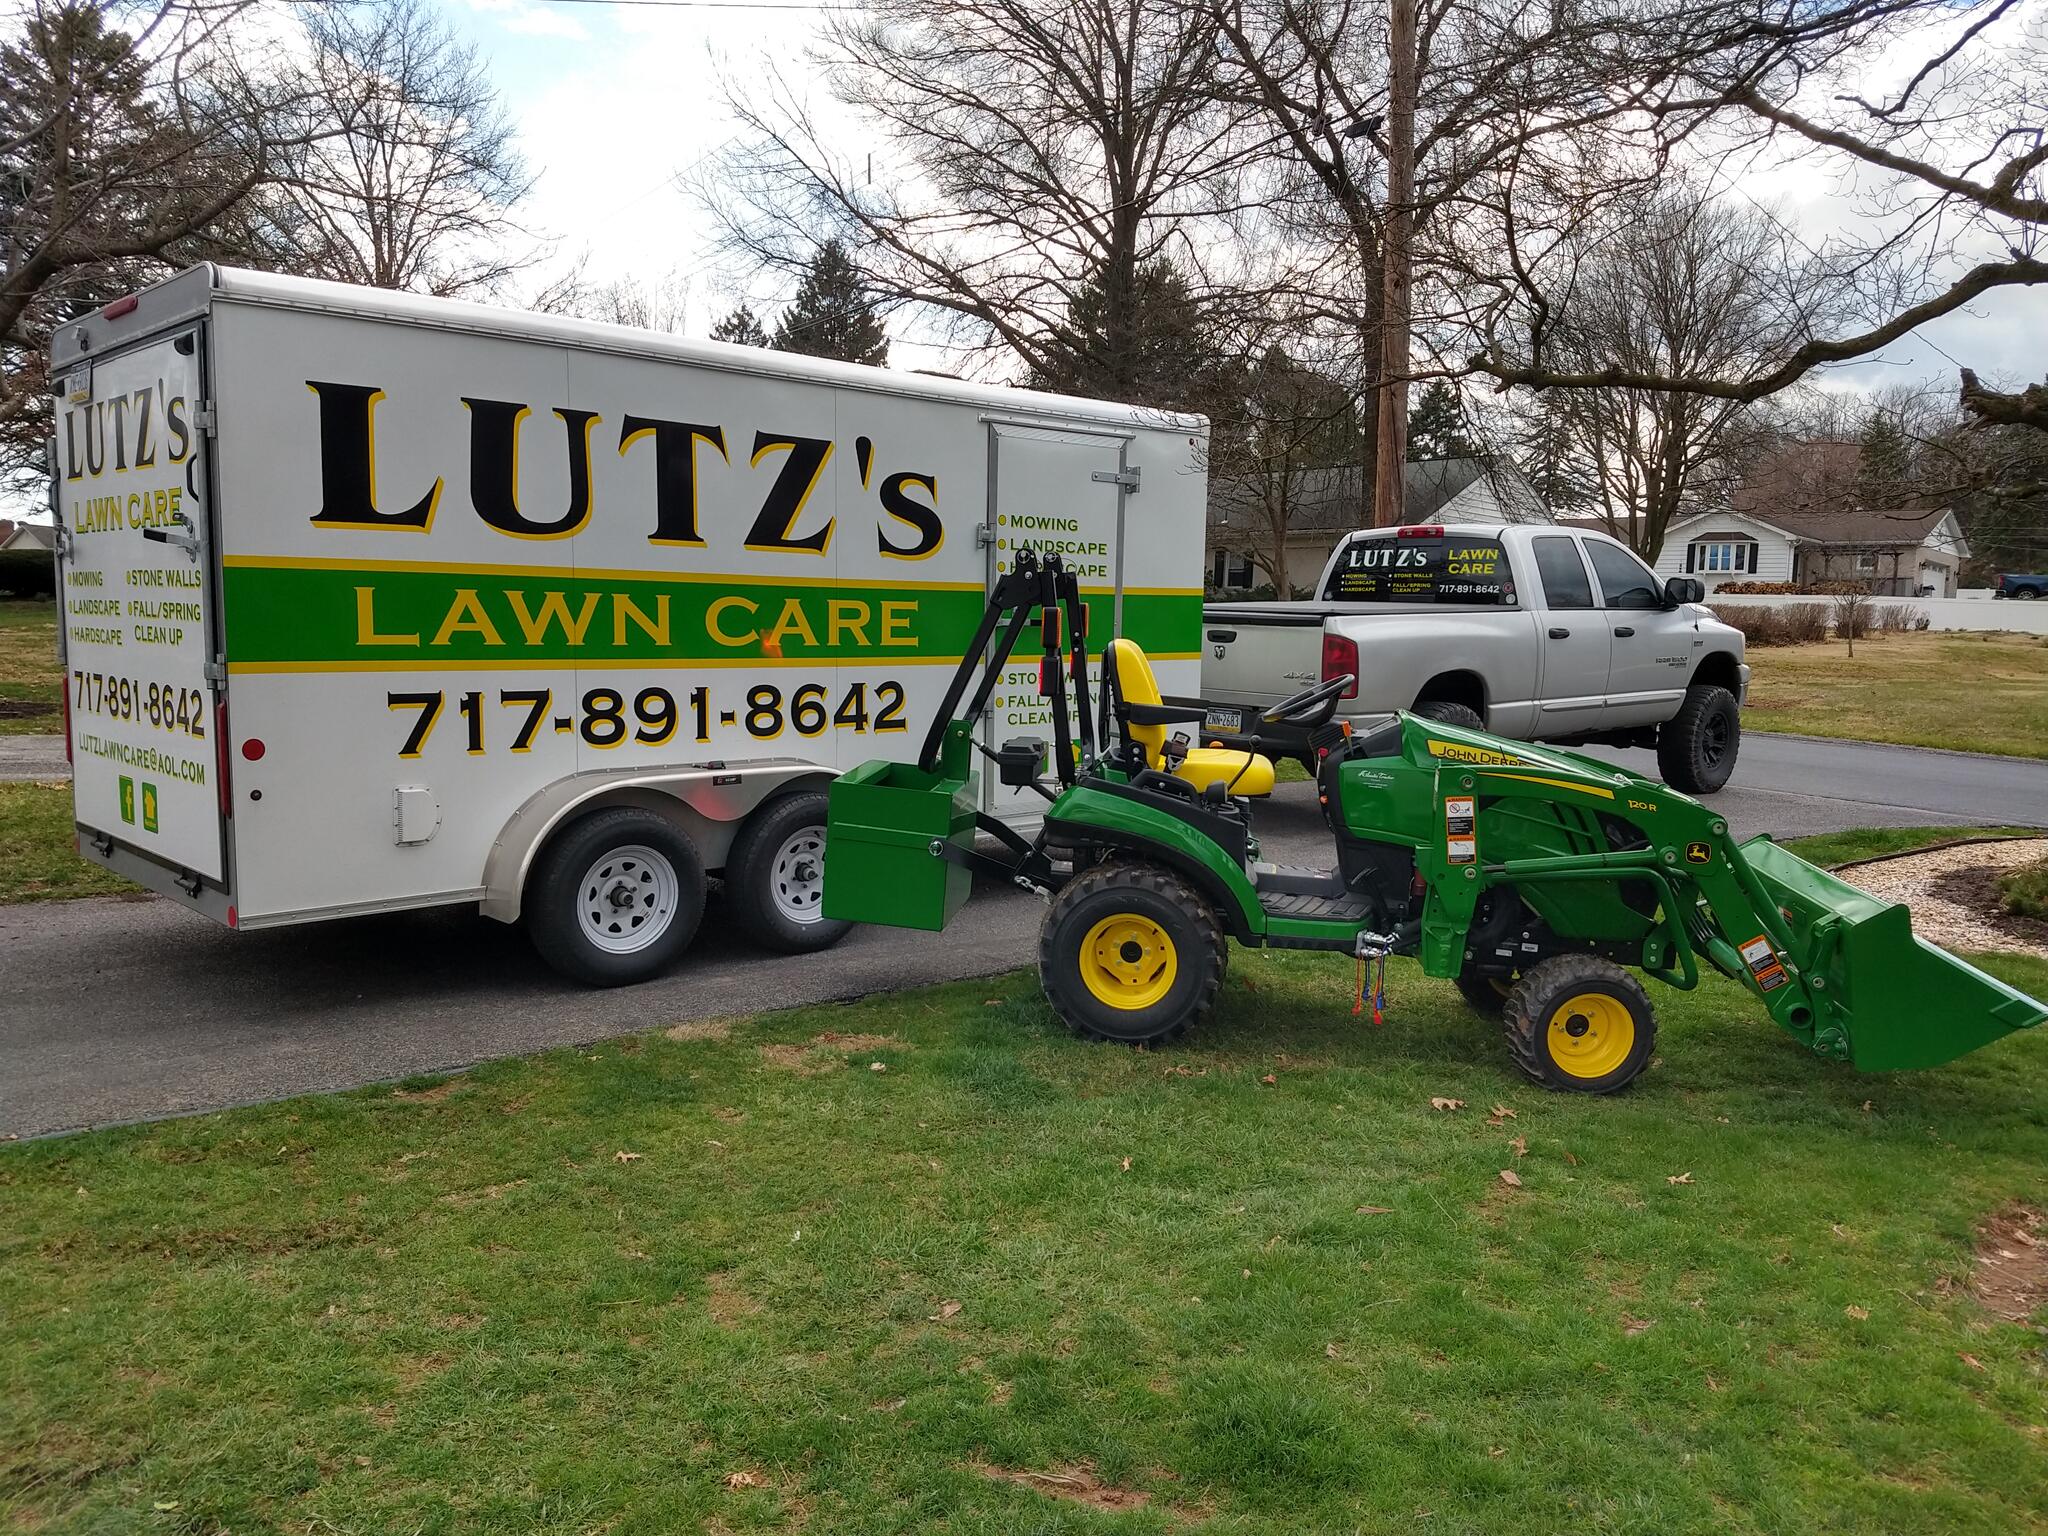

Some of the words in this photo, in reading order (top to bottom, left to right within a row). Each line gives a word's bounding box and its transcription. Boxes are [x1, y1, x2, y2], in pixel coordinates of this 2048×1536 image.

[74, 495, 123, 534] LAWN
[127, 486, 184, 529] CARE
[1011, 515, 1079, 531] MOWING
[1010, 538, 1108, 555] LANDSCAPE
[1448, 549, 1499, 560] LAWN
[1010, 561, 1108, 577] HRCAPE
[1448, 563, 1495, 574] CARE
[72, 571, 103, 587] MOWING
[131, 569, 163, 587] STONE
[165, 569, 201, 588] WALLS
[1440, 584, 1500, 594] 717-891-8642
[73, 599, 121, 616] LANDSCAPE
[133, 600, 201, 621] FALL/SPRING
[354, 586, 673, 647] LAWN
[705, 595, 920, 647] CARE
[74, 626, 122, 646] HARDSCAPE
[134, 624, 166, 643] CLEAN
[169, 628, 183, 645] UP
[74, 670, 205, 739] 717-891-8642
[386, 680, 909, 759] 717-891-8642
[79, 731, 205, 785] LUTZLAWNCARE@AOL.COM
[1438, 746, 1477, 761] JOHN
